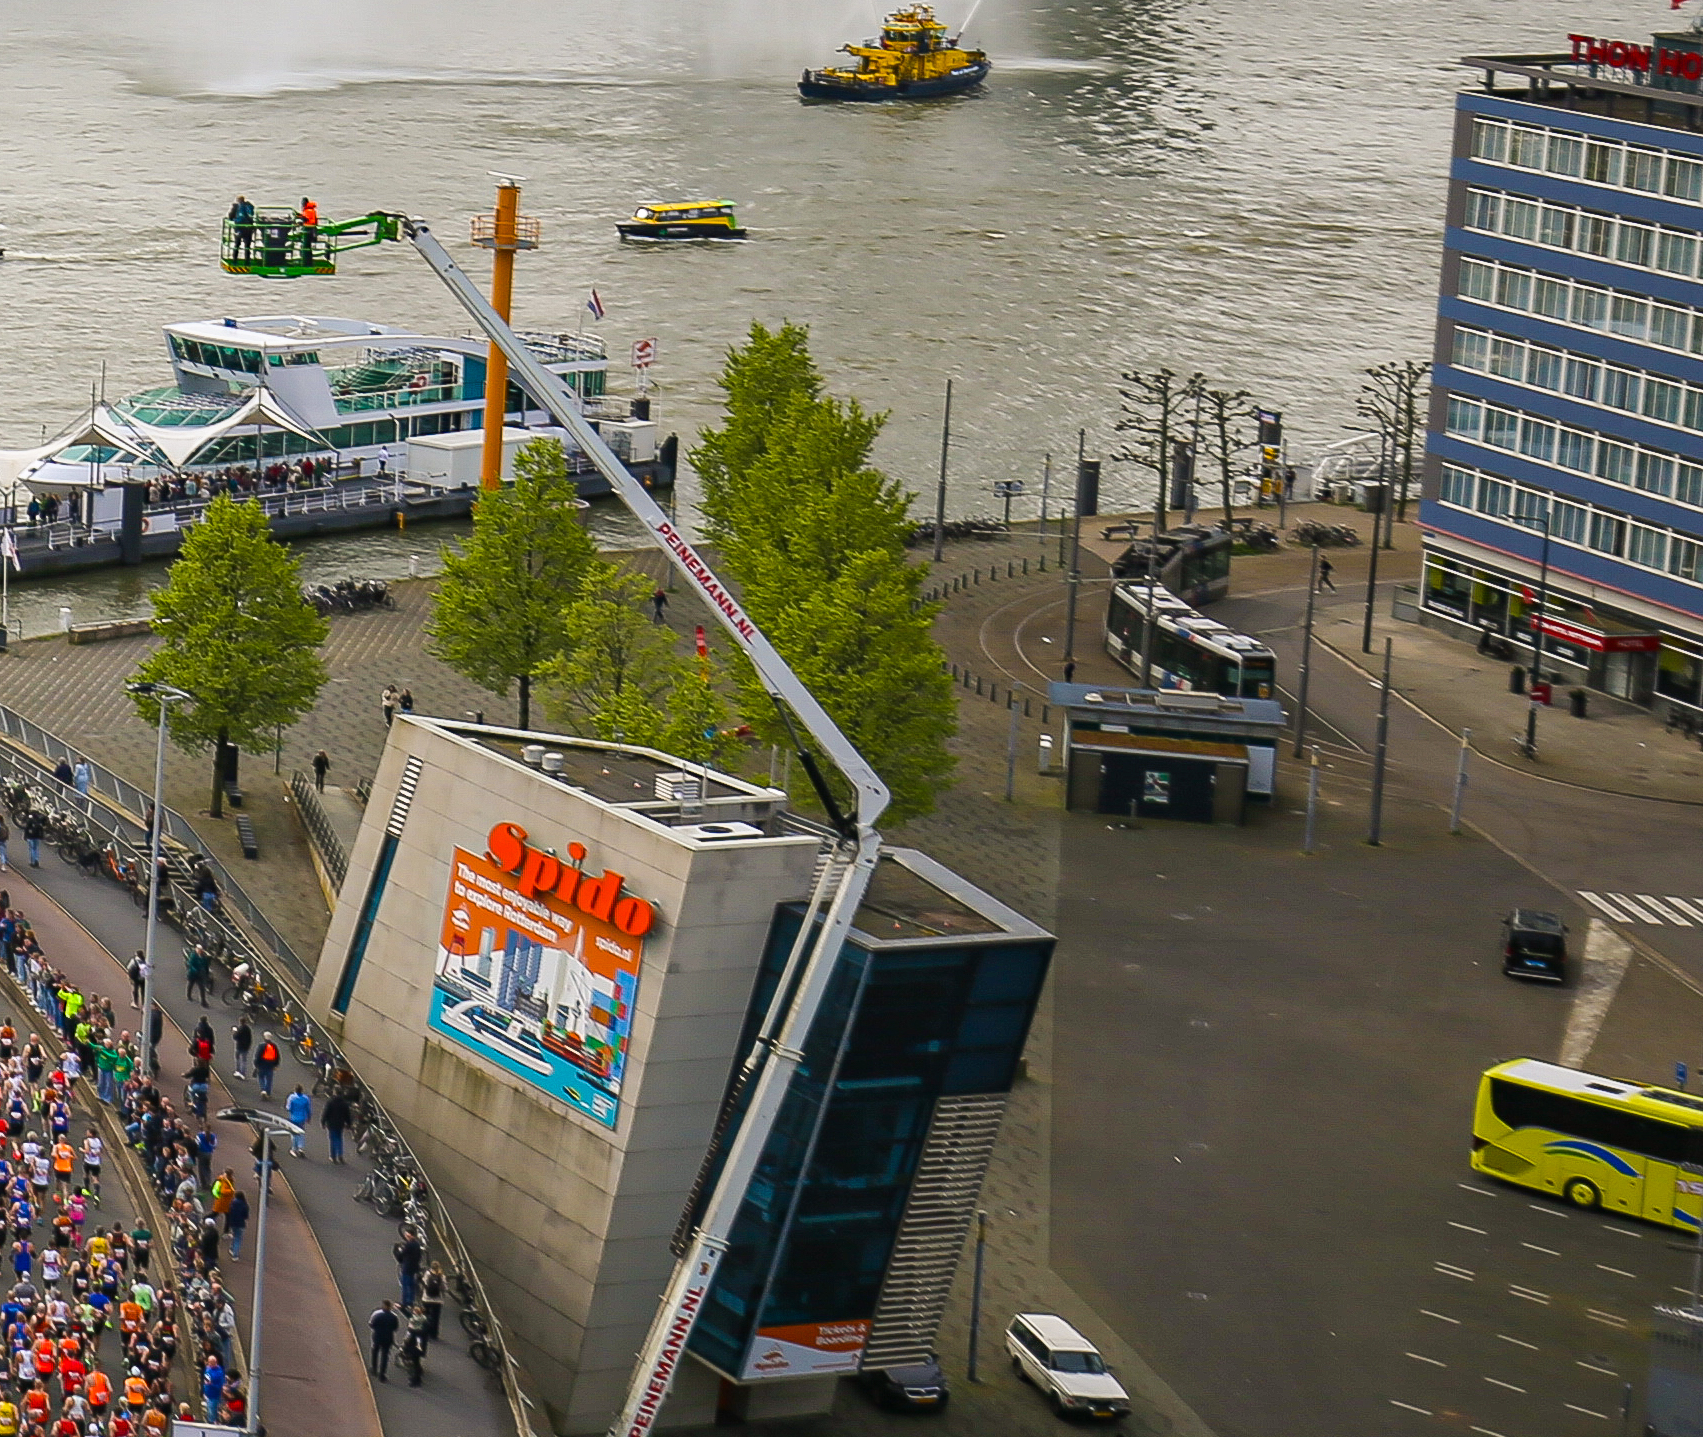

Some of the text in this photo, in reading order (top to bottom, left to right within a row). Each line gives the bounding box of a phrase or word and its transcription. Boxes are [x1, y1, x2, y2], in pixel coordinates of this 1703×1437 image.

[1567, 32, 1653, 73] THON
[656, 521, 757, 645] PEINEMANN.NL
[456, 861, 574, 934] The most enjoyable way
[484, 822, 654, 936] Spido
[454, 880, 558, 944] to explore Rotterdam
[595, 935, 634, 963] spido.nl
[815, 1335, 865, 1346] Boarding
[818, 1322, 867, 1336] Tickets &
[628, 1286, 705, 1437] PEINEMANN.NL
